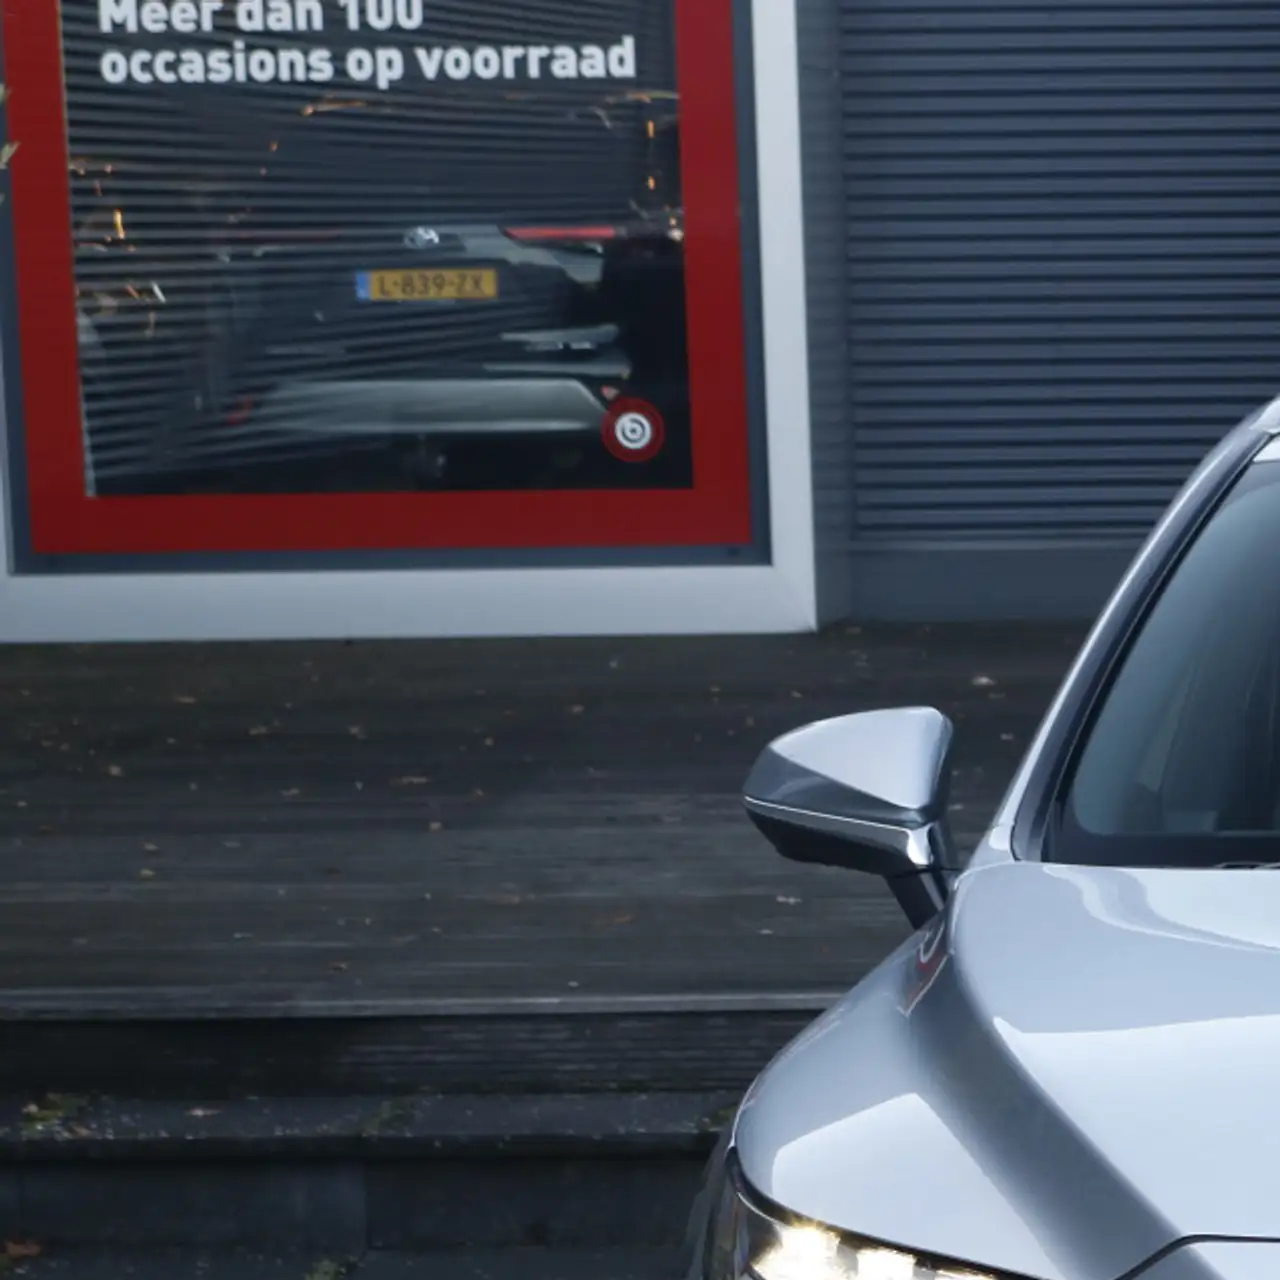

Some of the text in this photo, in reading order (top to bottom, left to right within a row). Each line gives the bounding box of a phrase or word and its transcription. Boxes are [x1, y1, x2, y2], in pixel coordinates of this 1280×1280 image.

[99, 0, 424, 33] Meer dan 100
[101, 34, 637, 89] occasions op voorraad
